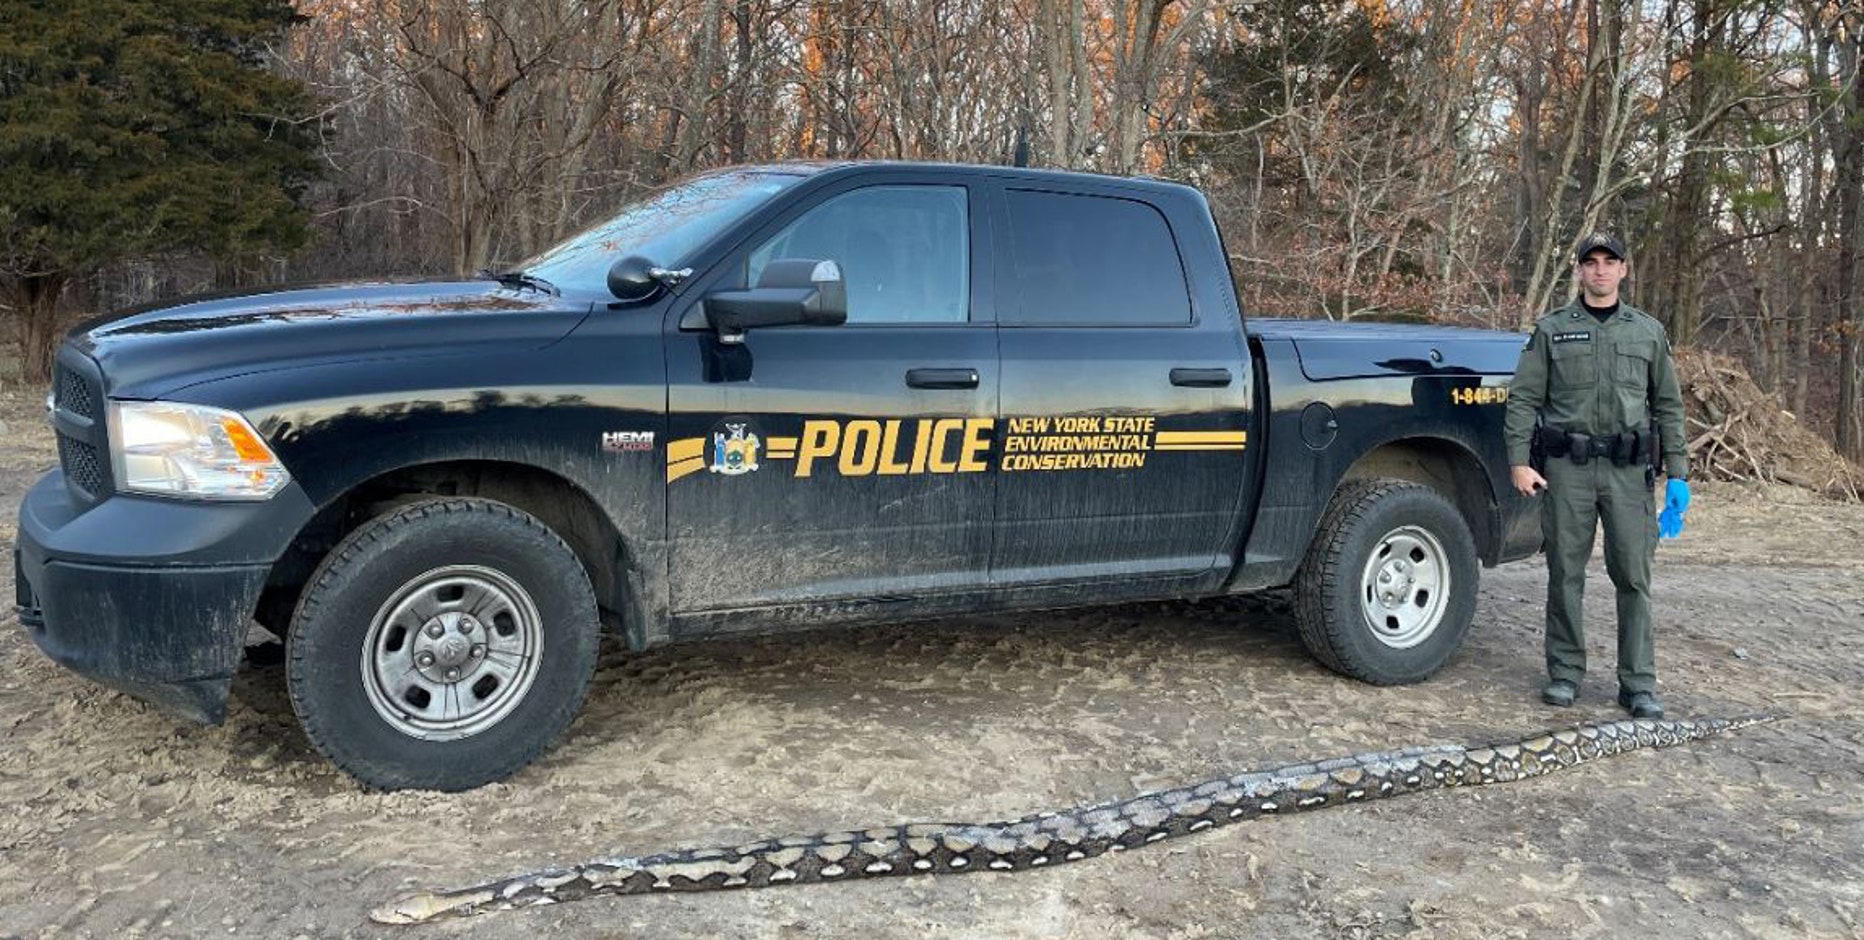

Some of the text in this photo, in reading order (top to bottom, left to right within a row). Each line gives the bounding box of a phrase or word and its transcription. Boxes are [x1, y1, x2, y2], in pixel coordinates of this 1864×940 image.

[1008, 417, 1155, 433] NEW YORK STATE
[602, 431, 655, 445] HEMI
[1004, 435, 1151, 452] ENVIRONMENTAL
[795, 418, 994, 477] POLICE
[1001, 453, 1145, 471] CONSERVATION
